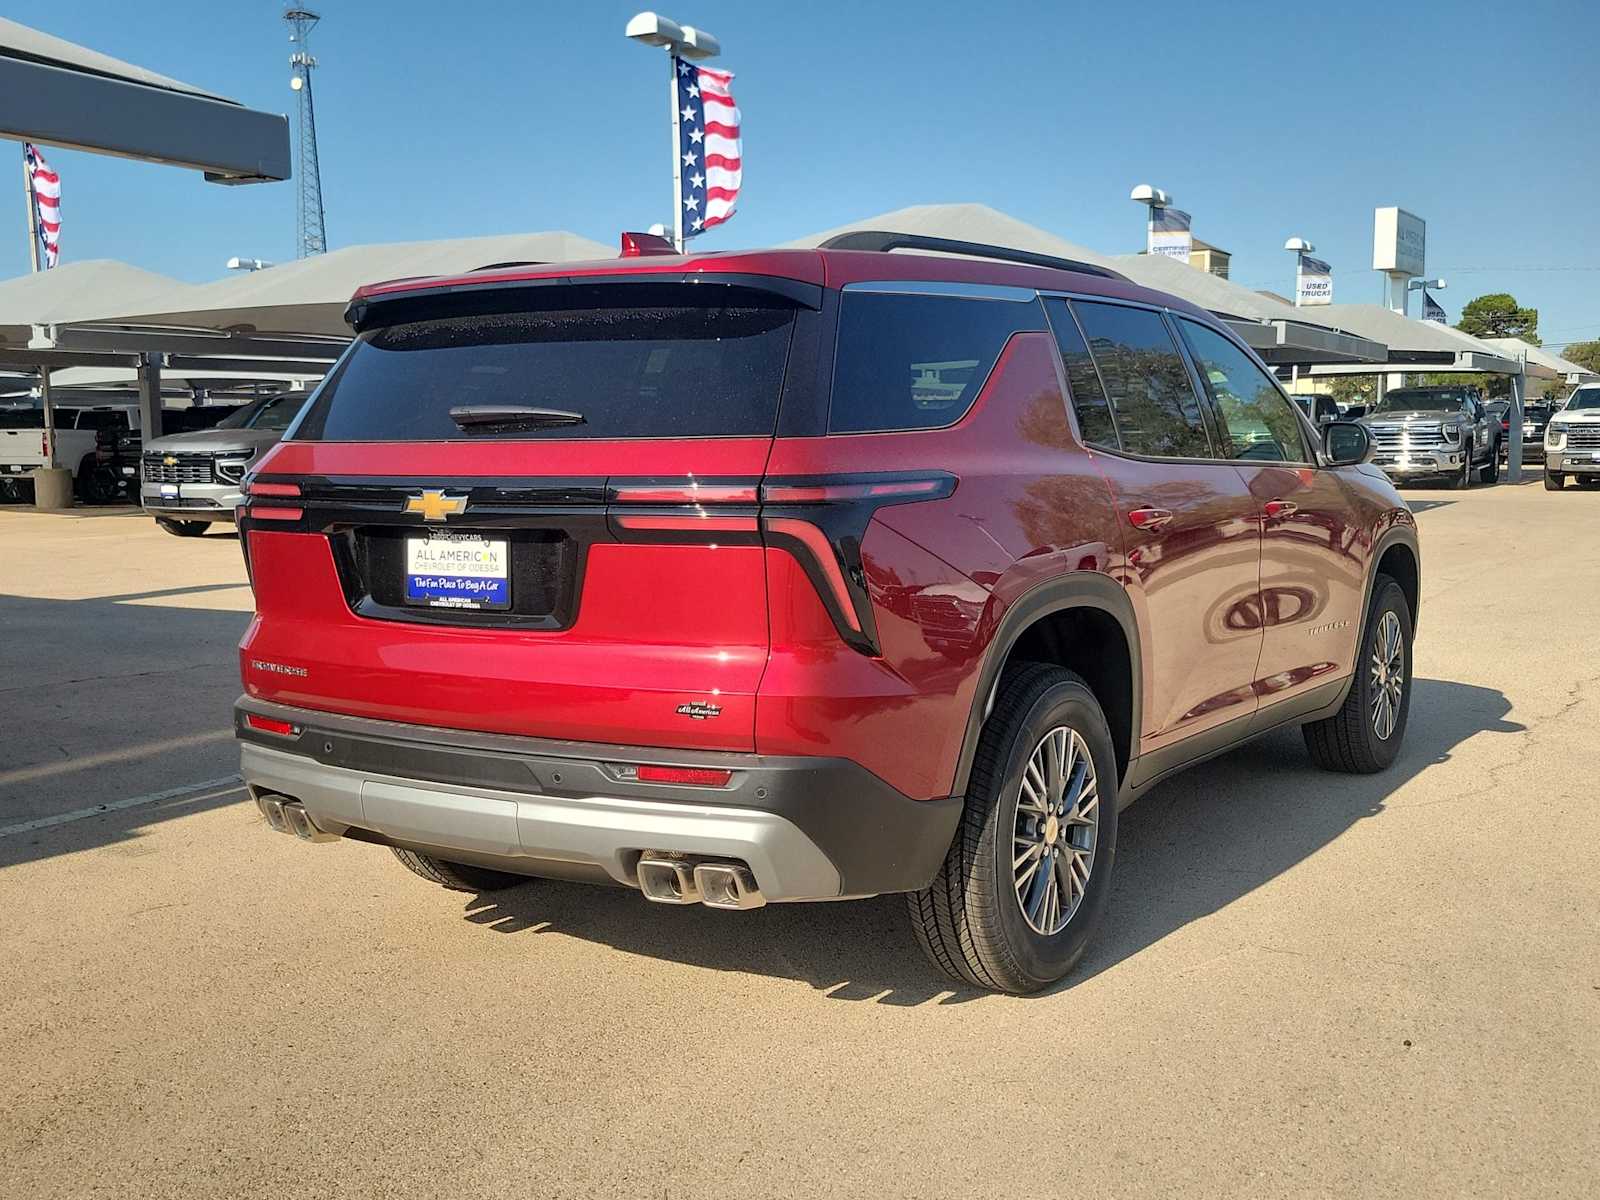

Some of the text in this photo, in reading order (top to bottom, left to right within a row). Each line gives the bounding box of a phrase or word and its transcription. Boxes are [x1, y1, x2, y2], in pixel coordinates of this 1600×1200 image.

[416, 550, 436, 561] ALL
[415, 561, 500, 573] CHEVROLET OF ODESSA
[415, 577, 426, 588] The
[439, 578, 456, 589] Place
[456, 579, 465, 589] To
[479, 580, 487, 590] A
[487, 581, 499, 591] Car
